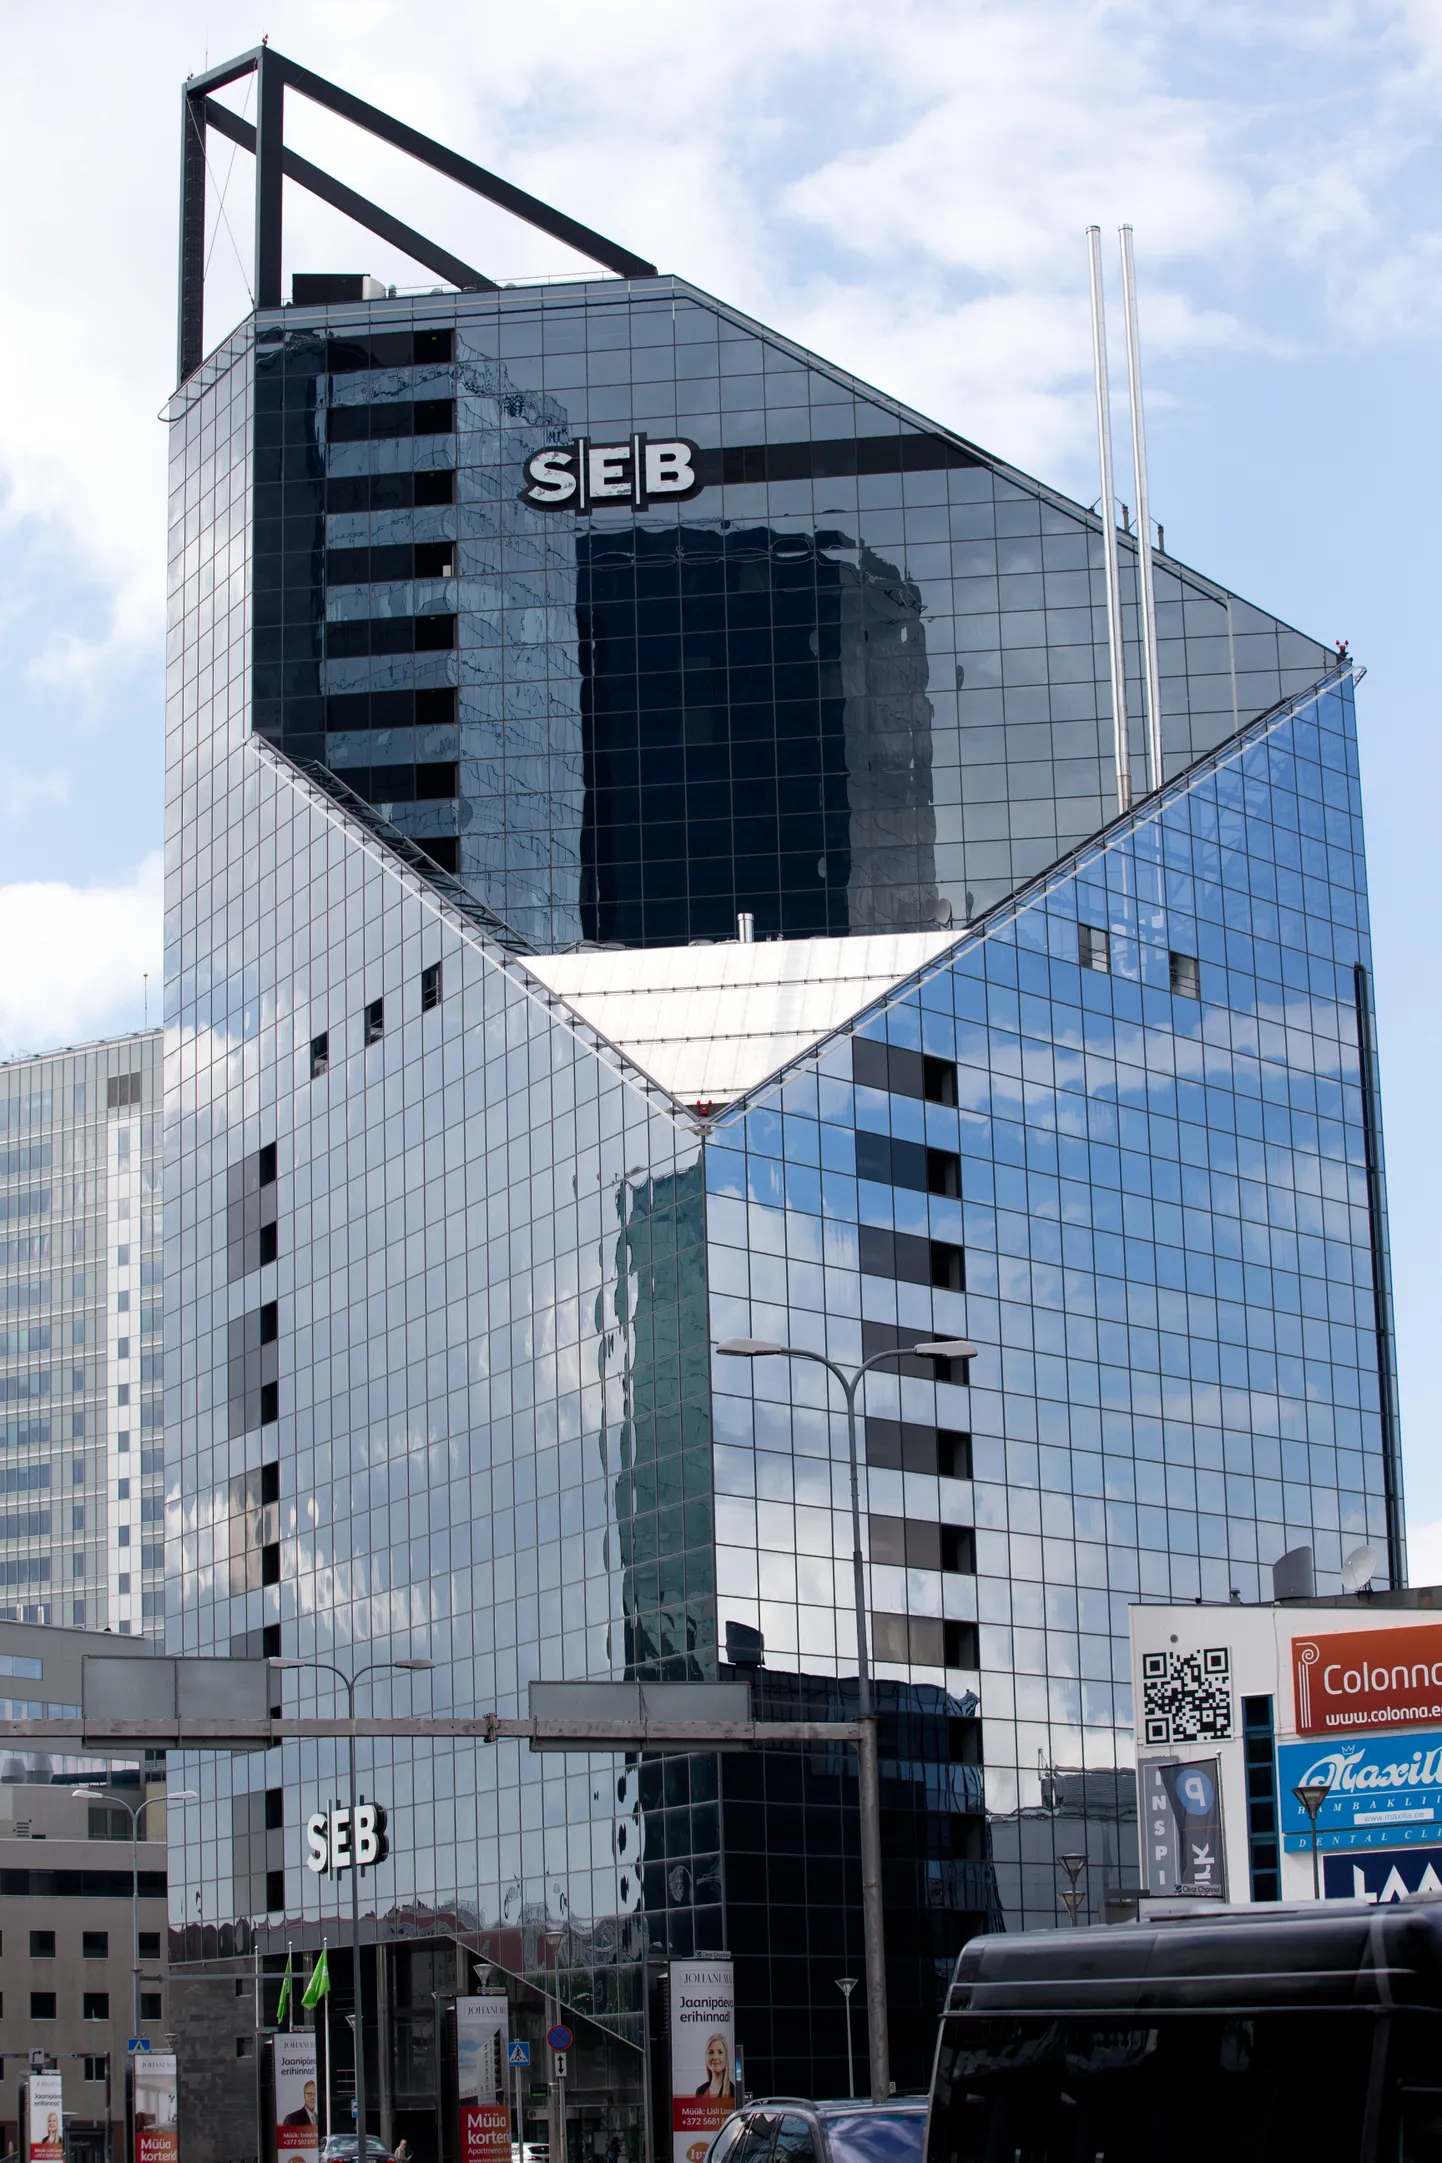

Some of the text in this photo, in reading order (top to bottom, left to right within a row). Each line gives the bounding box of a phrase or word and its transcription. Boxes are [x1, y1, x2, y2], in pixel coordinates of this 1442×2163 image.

[528, 440, 695, 503] SEB
[1325, 1705, 1442, 1726] www.colonna.e
[306, 1803, 382, 1874] SEB
[1298, 1833, 1388, 1848] DENTAL
[1182, 1884, 1221, 1893] Clear Channel
[683, 1973, 721, 1983] JOHANI
[467, 2113, 507, 2128] Müüa
[682, 2117, 701, 2125] +372
[702, 2117, 720, 2125] 5681
[140, 2138, 171, 2149] Müüa
